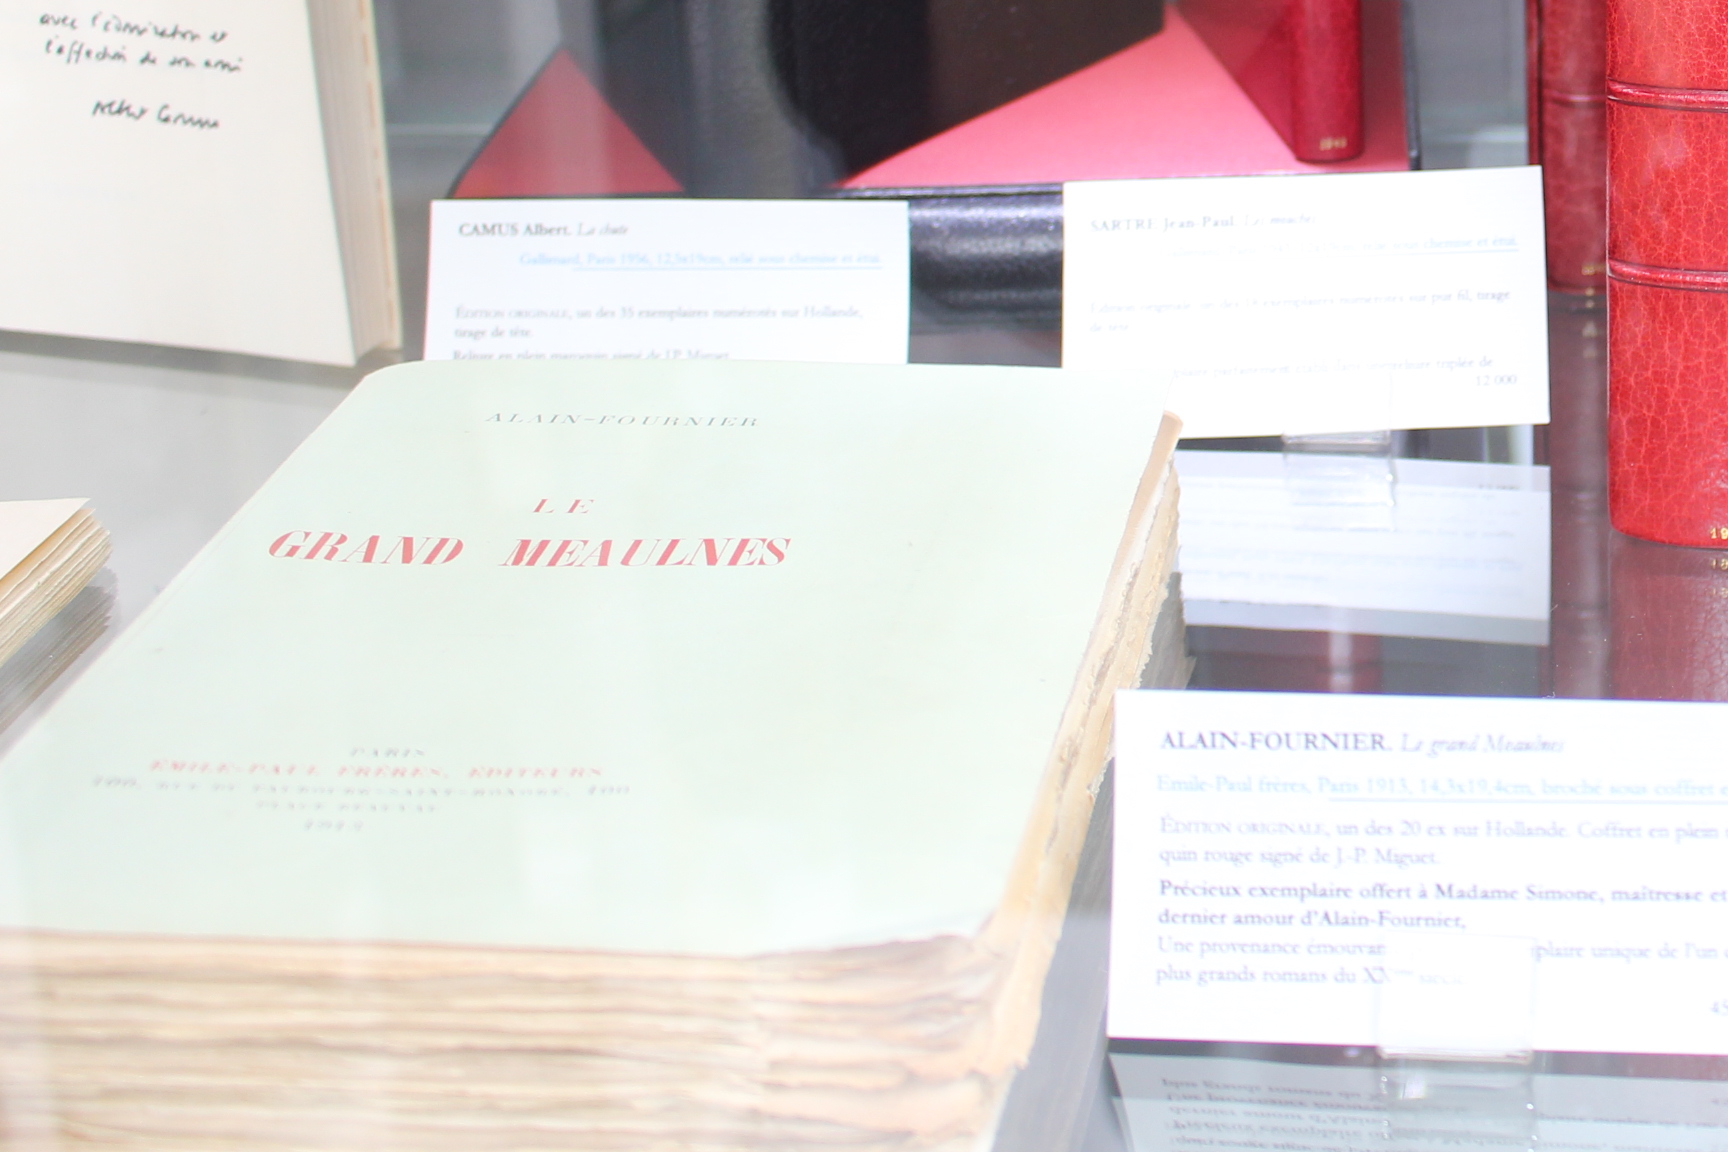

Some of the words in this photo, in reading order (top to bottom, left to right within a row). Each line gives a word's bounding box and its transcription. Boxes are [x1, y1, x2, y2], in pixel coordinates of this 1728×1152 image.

[457, 222, 519, 237] CAMUS
[522, 222, 571, 237] Albert.
[594, 306, 616, 319] des
[491, 326, 505, 337] de
[485, 412, 761, 427] ALAIN-FOURNIER
[532, 498, 597, 515] LE
[268, 530, 465, 566] GRAND
[497, 537, 793, 568] MEAULNES
[1161, 731, 1392, 752] ALAIN-FOURNIER.
[1401, 733, 1423, 752] Le
[1427, 735, 1480, 758] grand
[1317, 776, 1359, 794] Paris
[1336, 825, 1359, 836] un
[1363, 820, 1394, 836] des
[1400, 820, 1421, 836] 20
[1425, 826, 1447, 836] ex
[1452, 826, 1479, 837] sur
[1577, 822, 1642, 838] Coffret
[1647, 828, 1670, 838] en
[1674, 823, 1719, 844] plein
[1158, 850, 1198, 867] quin
[1203, 851, 1253, 867] rouge
[1259, 849, 1303, 868] signé
[1308, 847, 1330, 864] de
[1159, 879, 1242, 898] Précieux
[1247, 882, 1353, 904] exemplaire
[1358, 882, 1412, 900] offert
[1417, 884, 1428, 900] à
[1434, 883, 1519, 901] Madame
[1525, 884, 1605, 903] Simone,
[1611, 886, 1703, 902] maîtresse
[1709, 890, 1727, 902] et
[1157, 908, 1227, 925] dernier
[1232, 914, 1295, 926] amour
[1156, 936, 1194, 953] Une
[1199, 941, 1298, 958] provenance
[1658, 943, 1678, 959] de
[1156, 964, 1191, 986] plus
[1197, 965, 1256, 987] grands
[1263, 971, 1327, 983] romans
[1334, 967, 1356, 984] du
